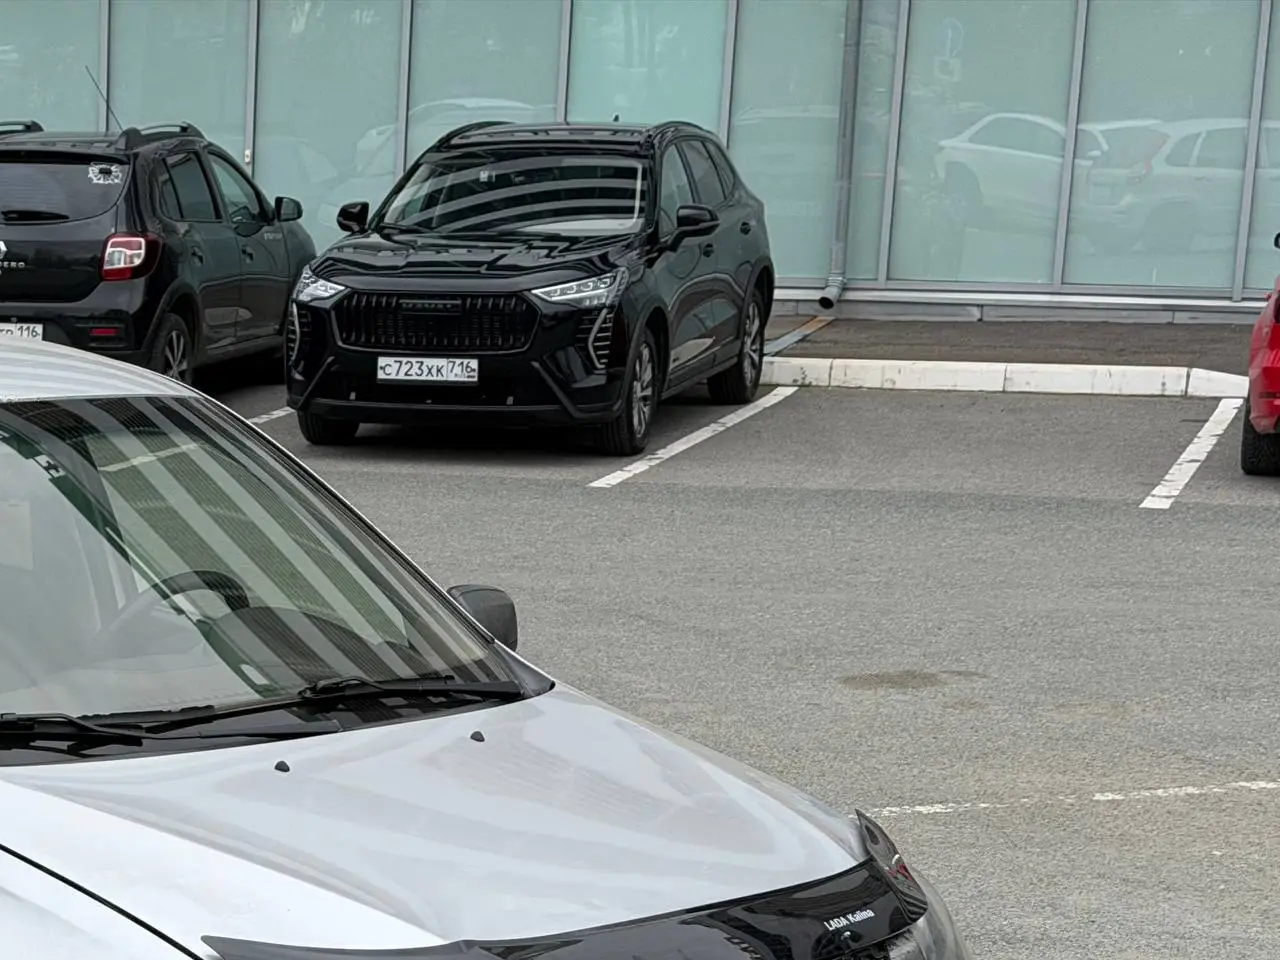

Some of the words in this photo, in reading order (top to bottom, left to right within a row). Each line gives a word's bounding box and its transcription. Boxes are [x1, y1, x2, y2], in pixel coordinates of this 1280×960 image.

[17, 325, 39, 338] 116
[447, 361, 473, 374] 716
[823, 916, 850, 931] LADA
[846, 909, 876, 923] Kalina
